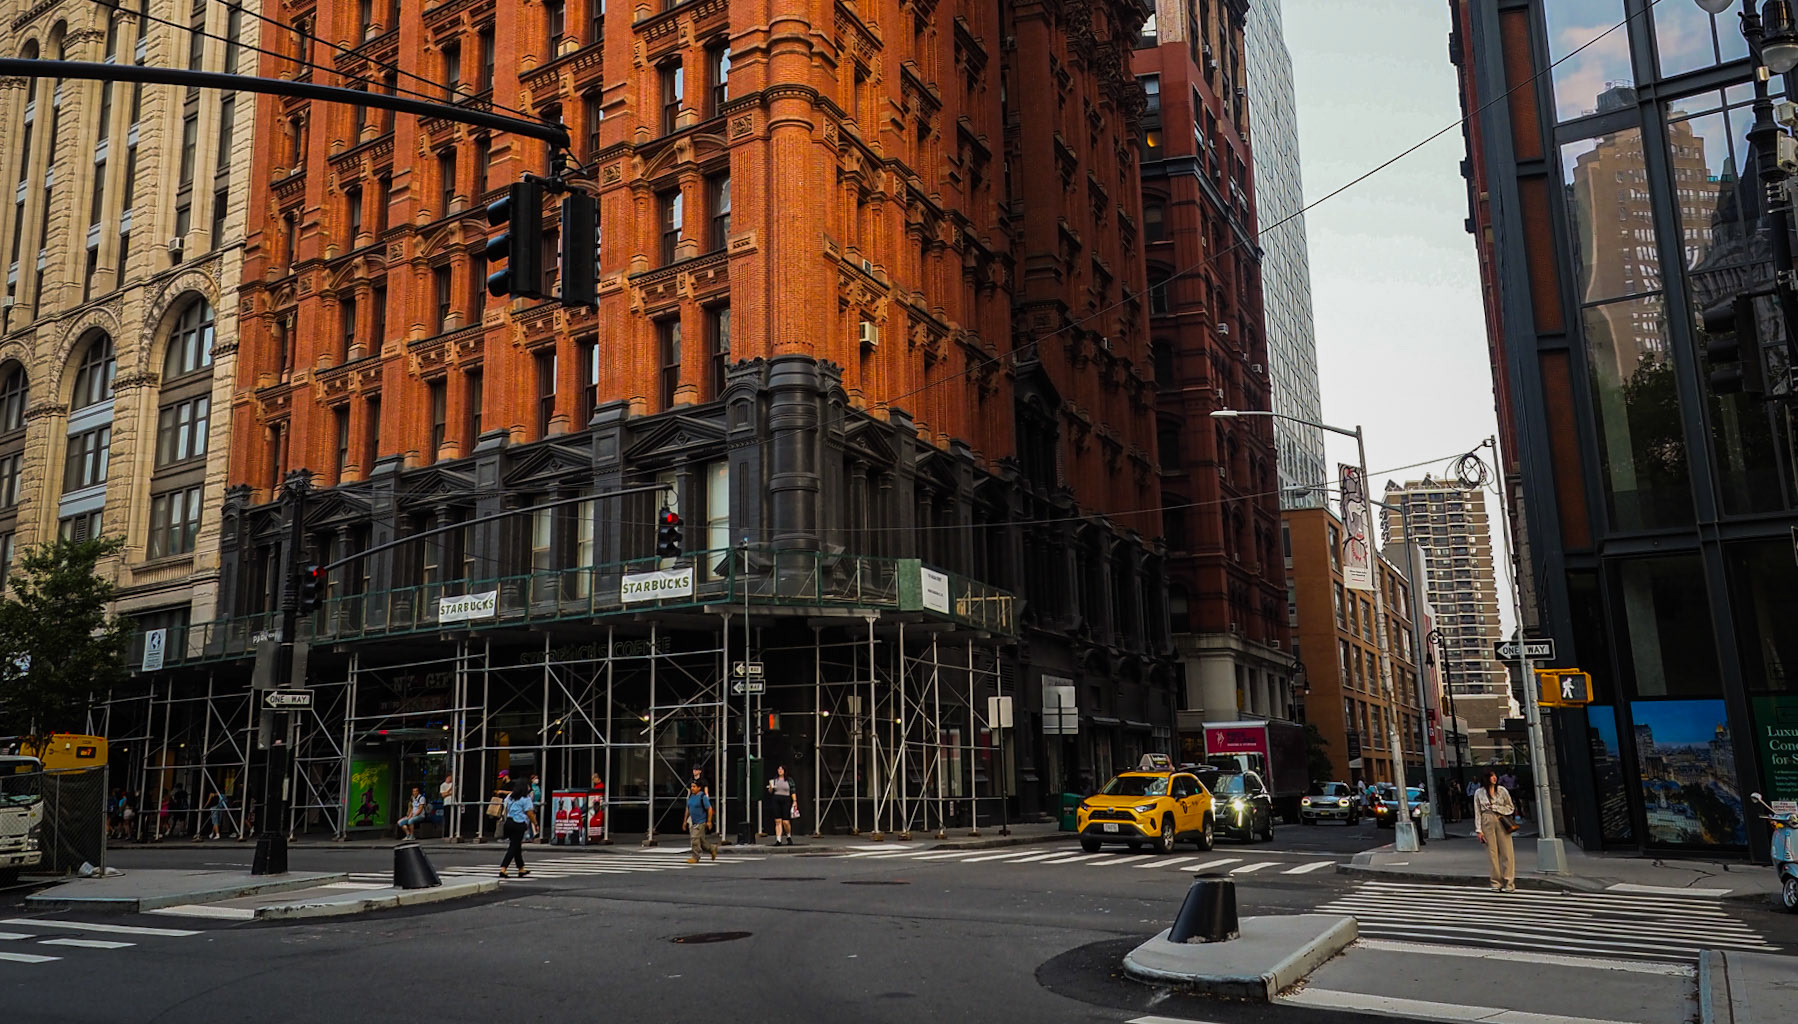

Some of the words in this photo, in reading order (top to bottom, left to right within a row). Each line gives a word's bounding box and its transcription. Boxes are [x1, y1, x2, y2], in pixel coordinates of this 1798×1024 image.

[622, 577, 690, 594] STARBUCKS
[440, 599, 494, 615] STARBUCKS
[1502, 647, 1520, 655] ONE
[1527, 645, 1546, 654] WAY
[1772, 753, 1789, 765] for
